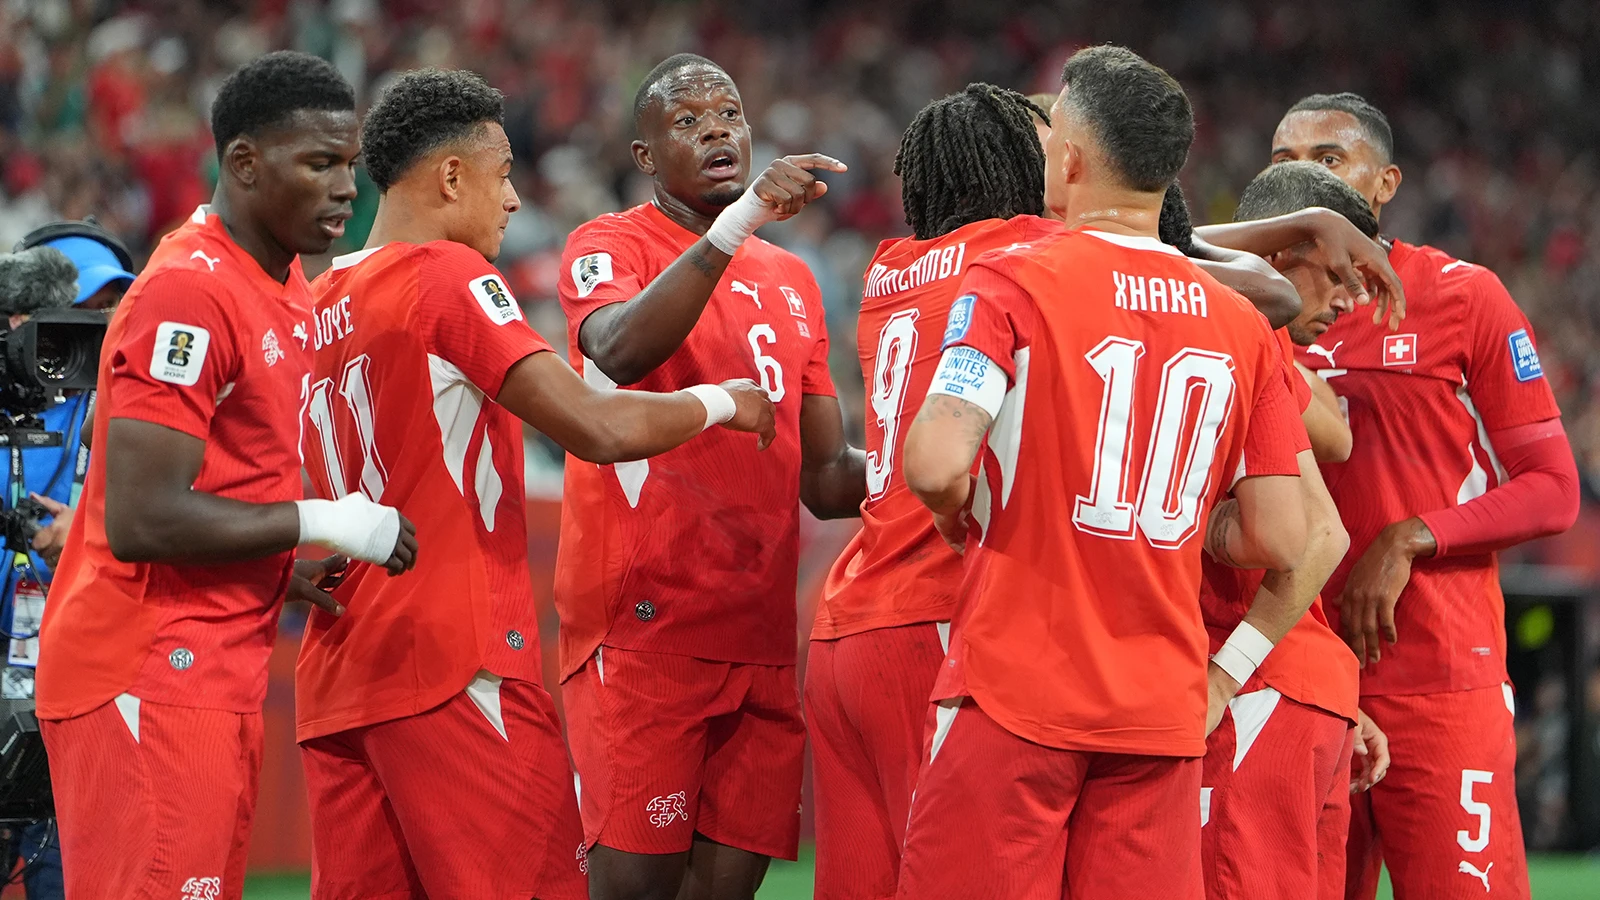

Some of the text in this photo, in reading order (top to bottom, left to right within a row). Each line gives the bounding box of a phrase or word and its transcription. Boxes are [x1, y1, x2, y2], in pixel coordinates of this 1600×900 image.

[1112, 270, 1208, 318] XHAKA
[747, 323, 785, 402] 6
[945, 356, 987, 378] UNITES
[951, 347, 990, 366] FOOTBALL
[952, 371, 984, 391] World
[865, 307, 921, 501] 9
[1072, 335, 1236, 550] 10
[1456, 769, 1495, 853] 5
